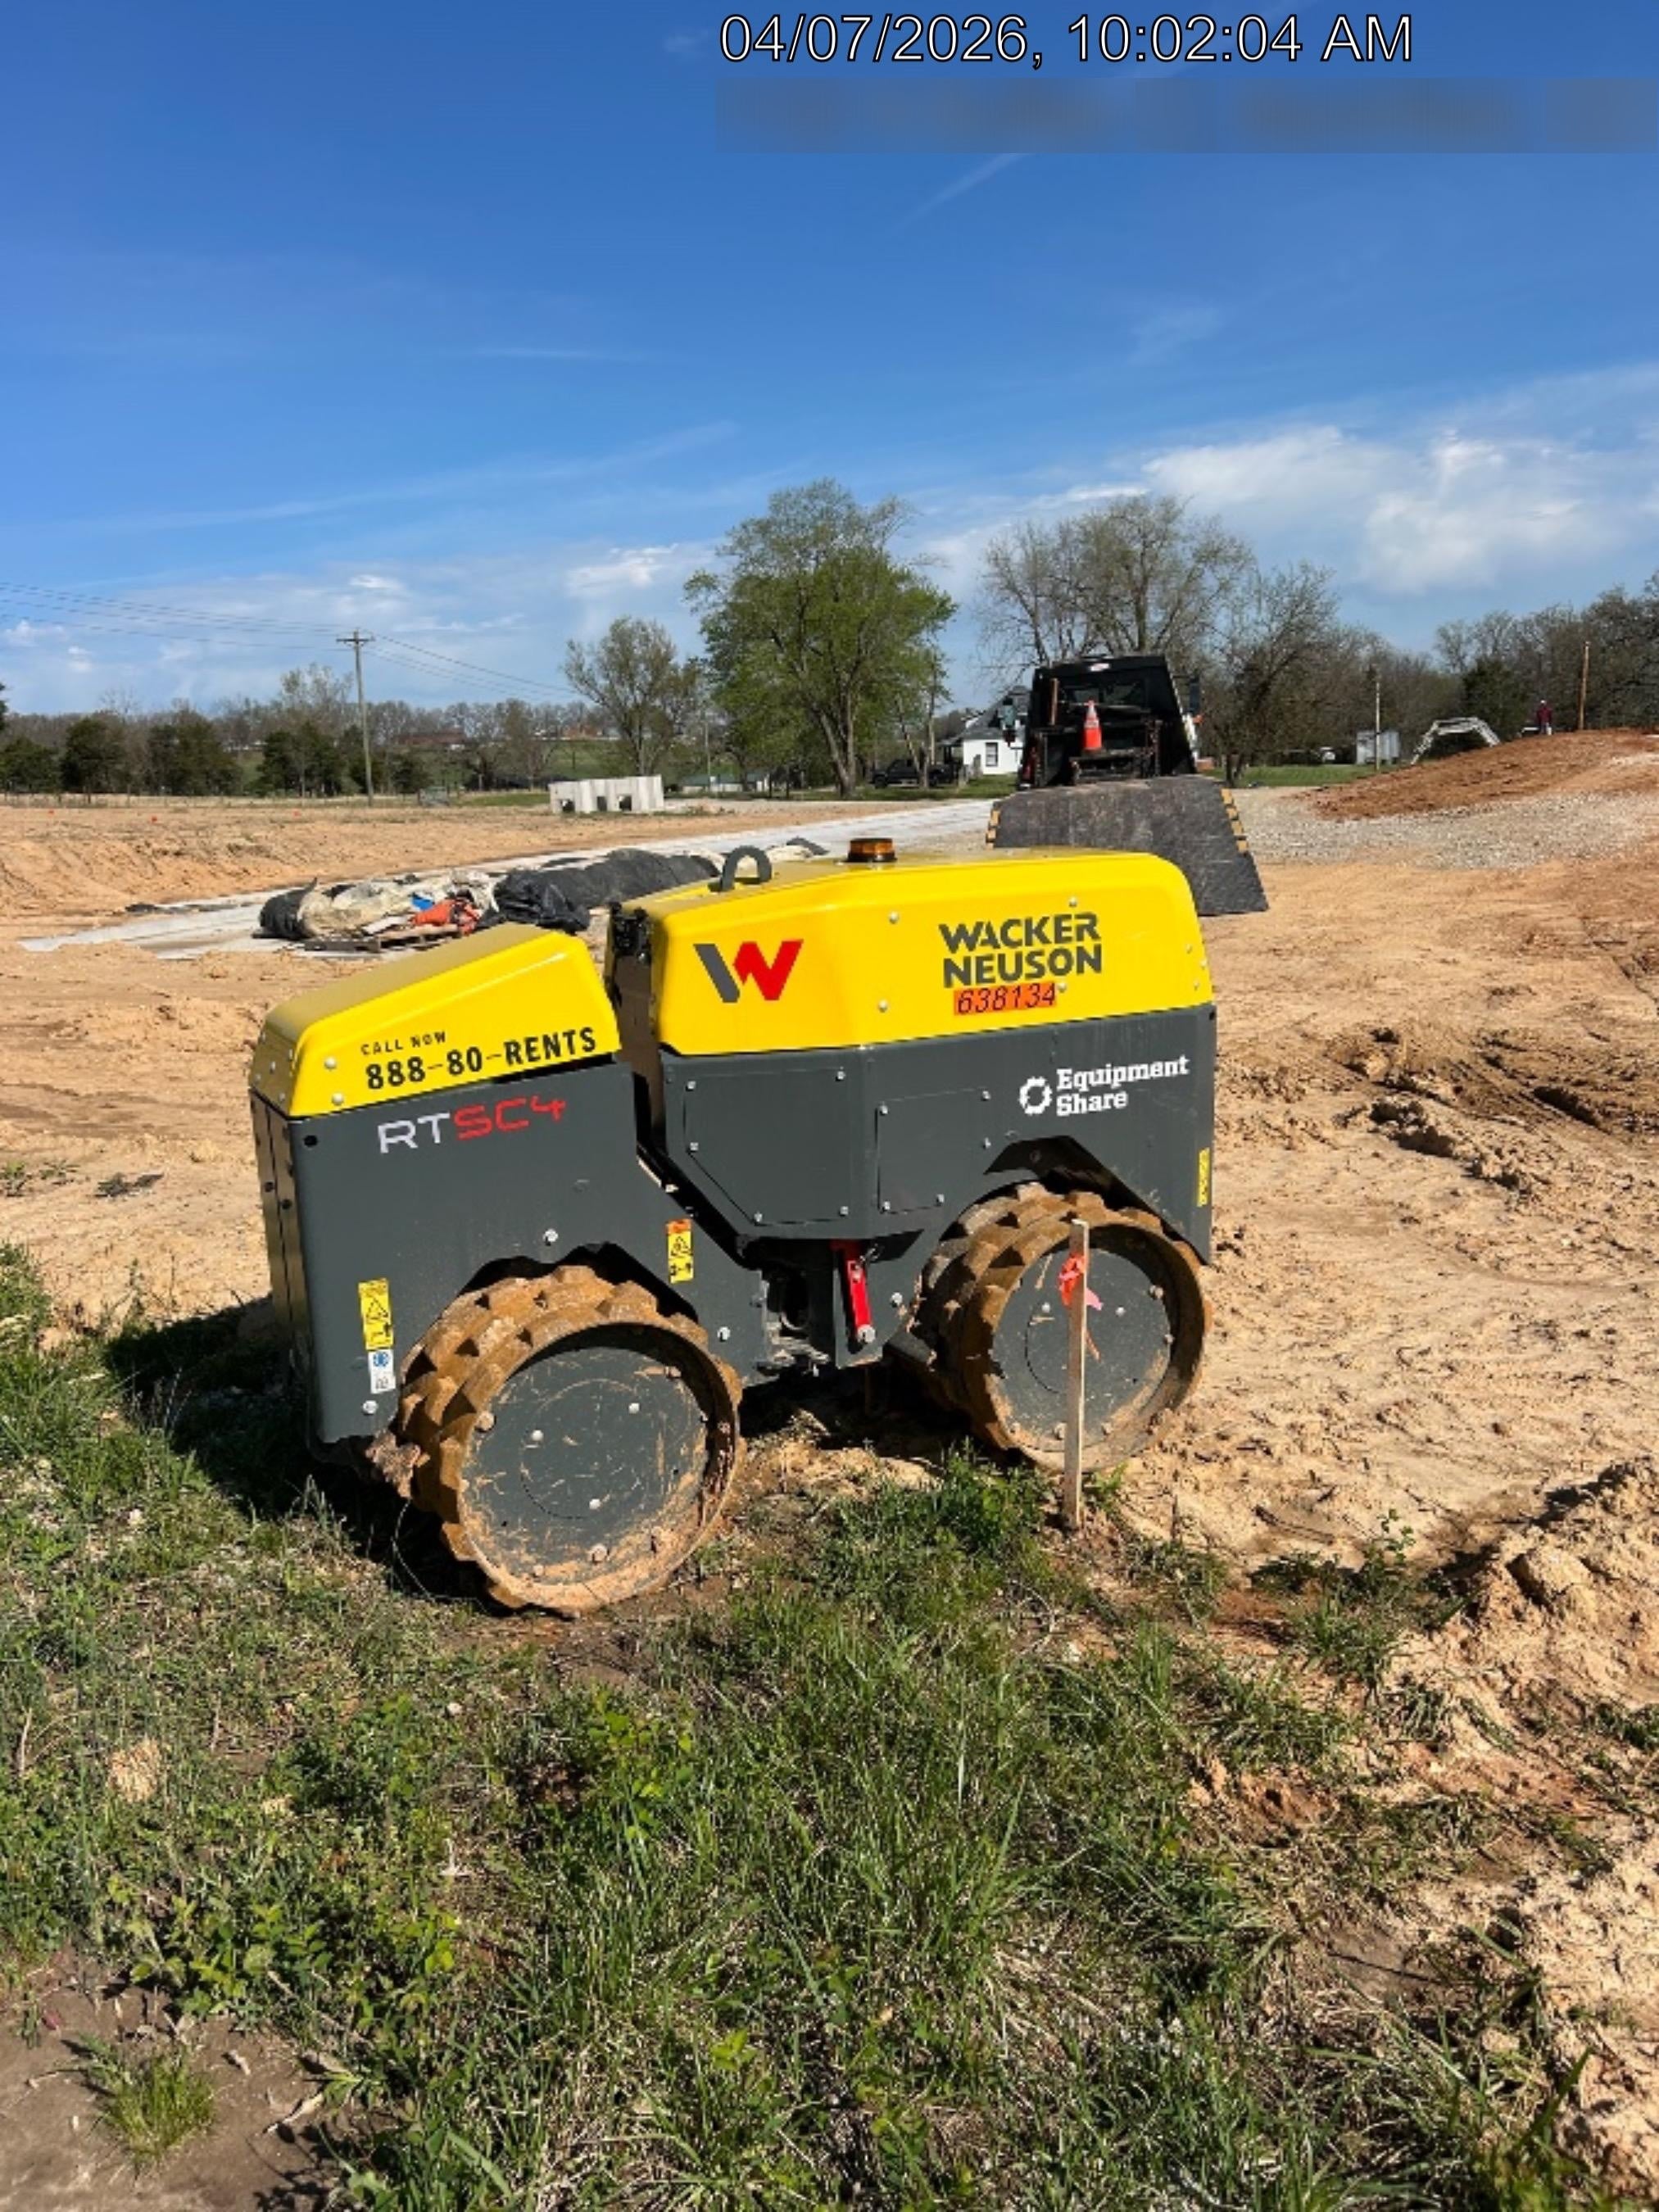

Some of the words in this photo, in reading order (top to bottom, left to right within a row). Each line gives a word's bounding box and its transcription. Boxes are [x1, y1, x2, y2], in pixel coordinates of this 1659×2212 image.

[938, 912, 1101, 954] WACKER
[943, 944, 1102, 988] NEUSON
[957, 982, 1056, 1015] 638134
[360, 1039, 403, 1055] CALL
[410, 1031, 446, 1048] NOW
[365, 1027, 596, 1090] 888-80-RENTS
[1056, 1054, 1190, 1092] Equipment
[1056, 1090, 1129, 1117] Share
